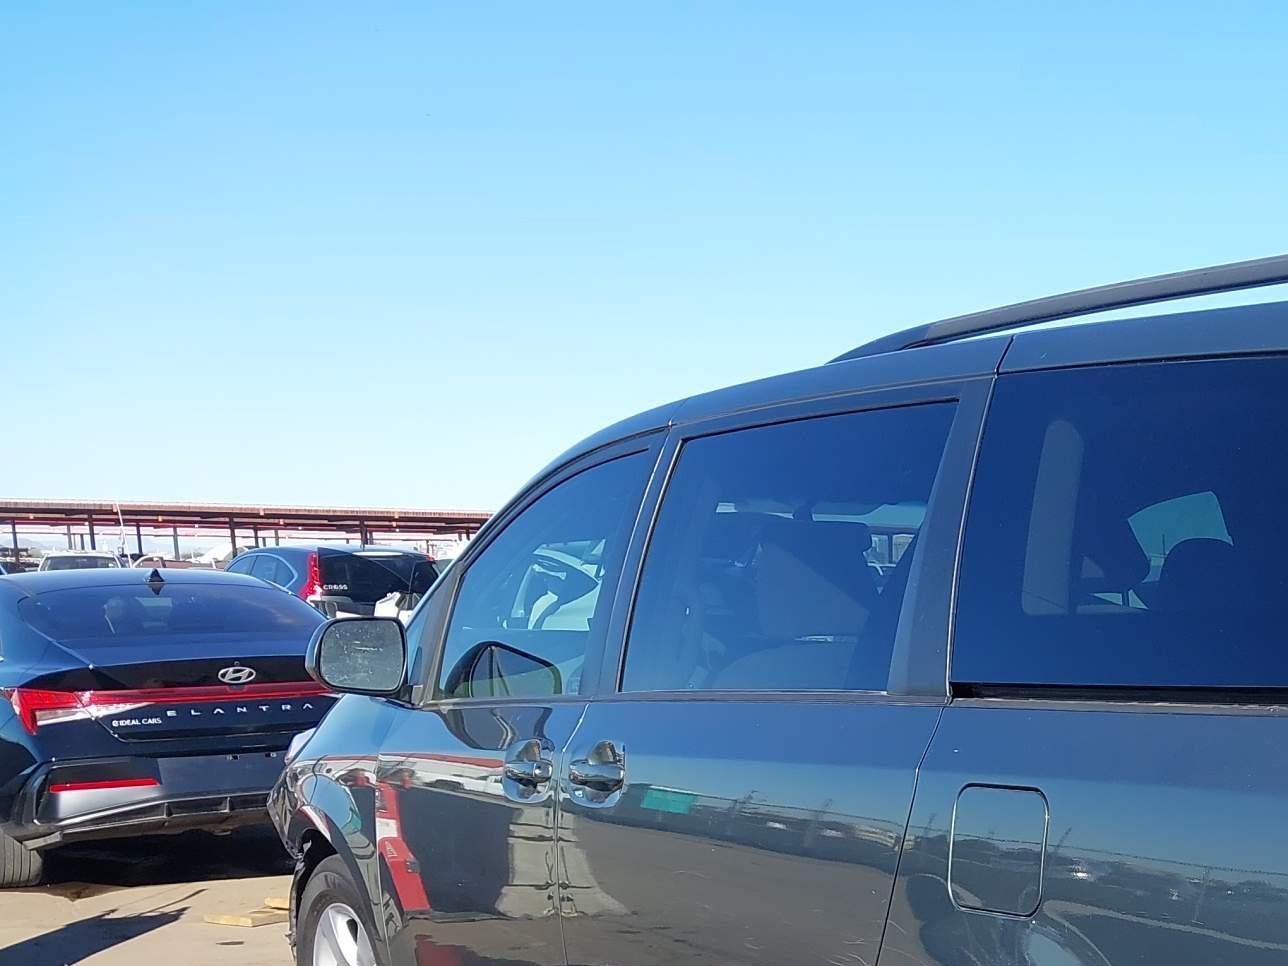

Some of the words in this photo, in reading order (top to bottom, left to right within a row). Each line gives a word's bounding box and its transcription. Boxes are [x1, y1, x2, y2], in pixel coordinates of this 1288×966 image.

[166, 703, 313, 717] ELANTRA
[119, 718, 141, 726] IDEAL
[141, 717, 163, 725] CARS
